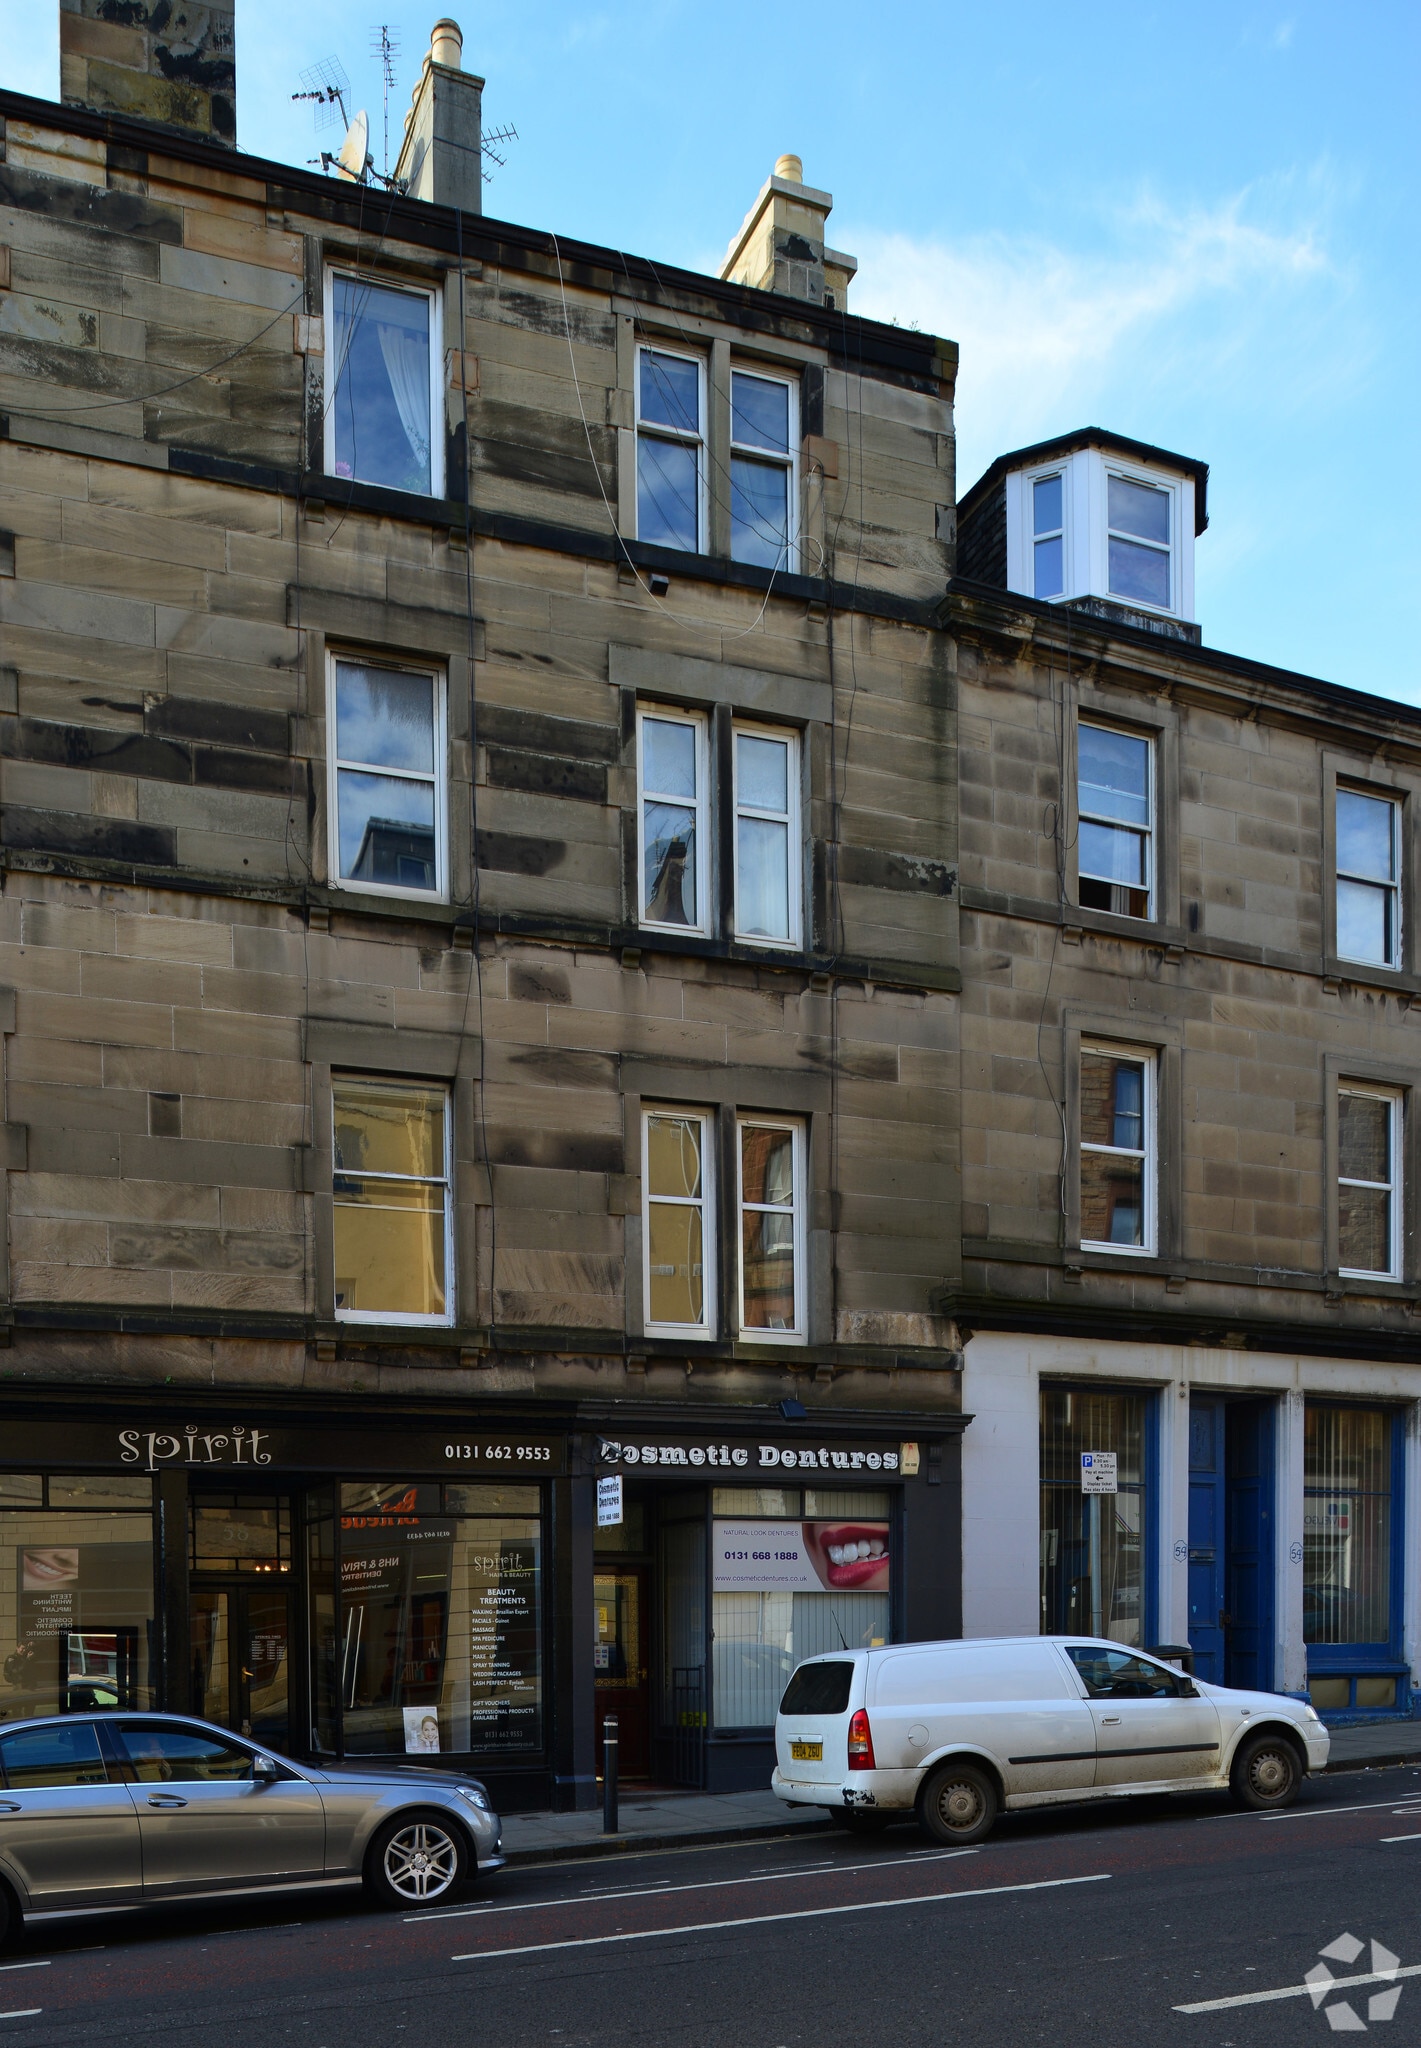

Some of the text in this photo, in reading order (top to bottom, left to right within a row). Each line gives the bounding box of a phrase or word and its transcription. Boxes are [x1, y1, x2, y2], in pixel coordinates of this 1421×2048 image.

[118, 1424, 272, 1472] spirit
[444, 1445, 551, 1460] 0131 662 9553
[600, 1441, 899, 1469] Cosmetic Dentures
[1084, 1456, 1091, 1467] P
[599, 1482, 619, 1495] Cosmetic
[599, 1496, 620, 1508] Dentures
[724, 1551, 798, 1560] 0131 668 1888
[474, 1552, 523, 1576] spirit
